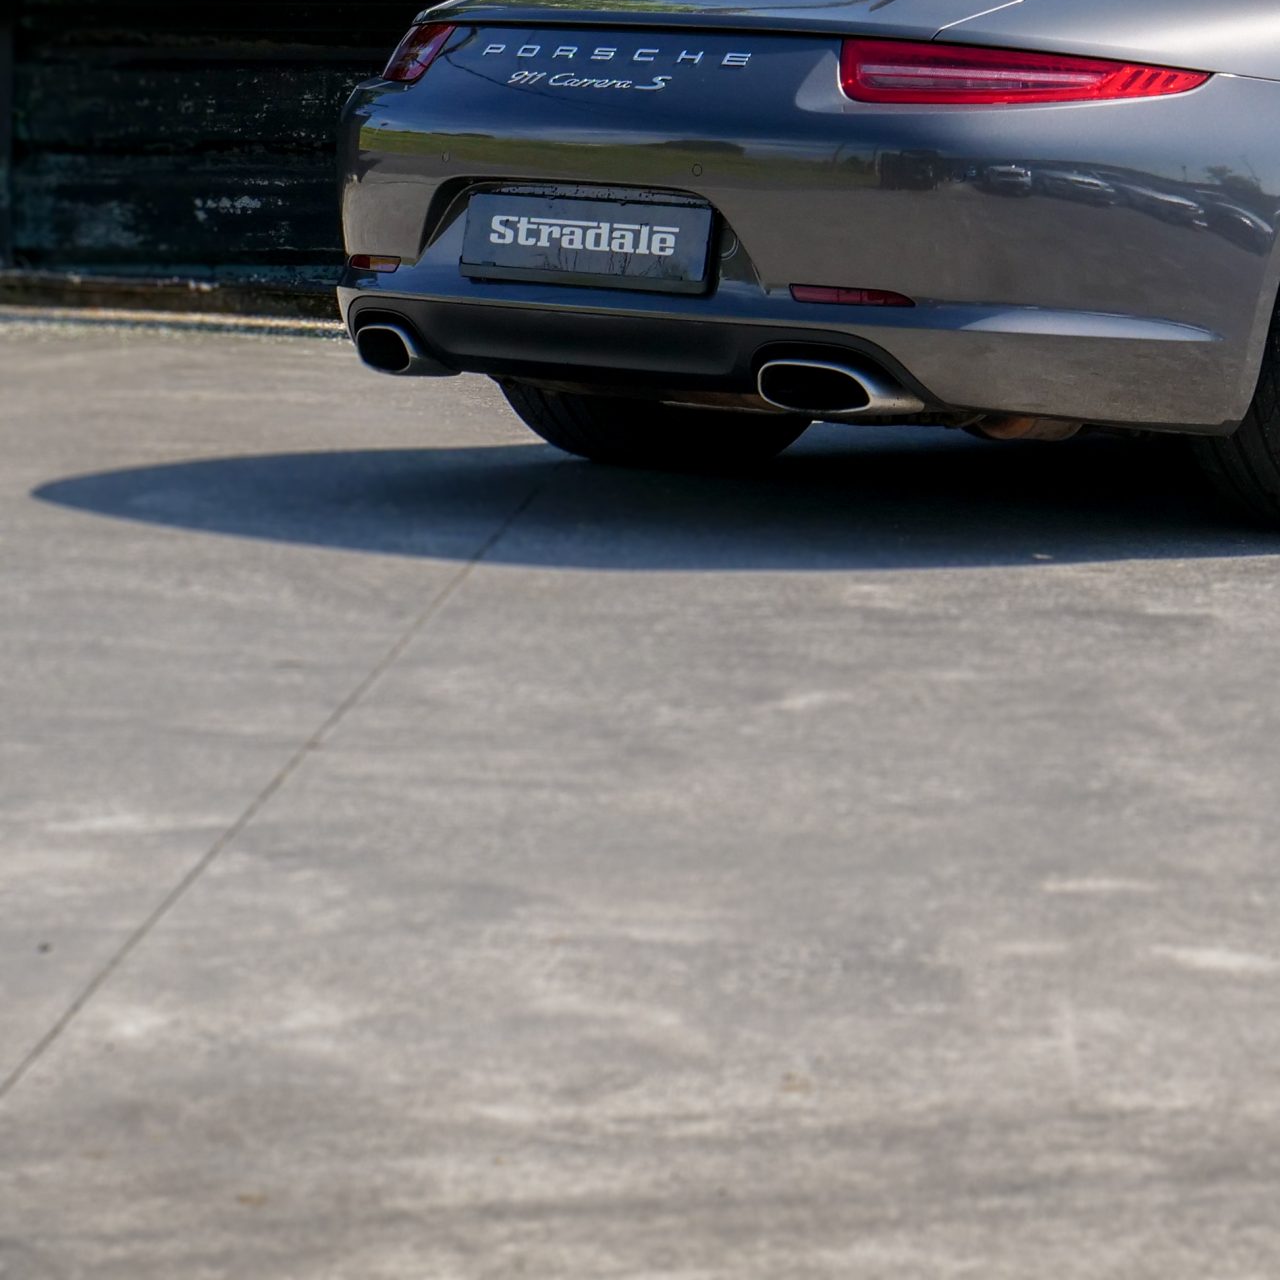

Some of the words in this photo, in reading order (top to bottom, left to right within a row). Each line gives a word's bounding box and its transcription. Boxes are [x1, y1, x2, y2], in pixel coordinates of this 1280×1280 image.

[482, 43, 752, 67] PORSCHE
[507, 70, 547, 84] 911
[548, 72, 633, 89] Carrera
[634, 75, 673, 90] S
[489, 215, 680, 256] Stradale
